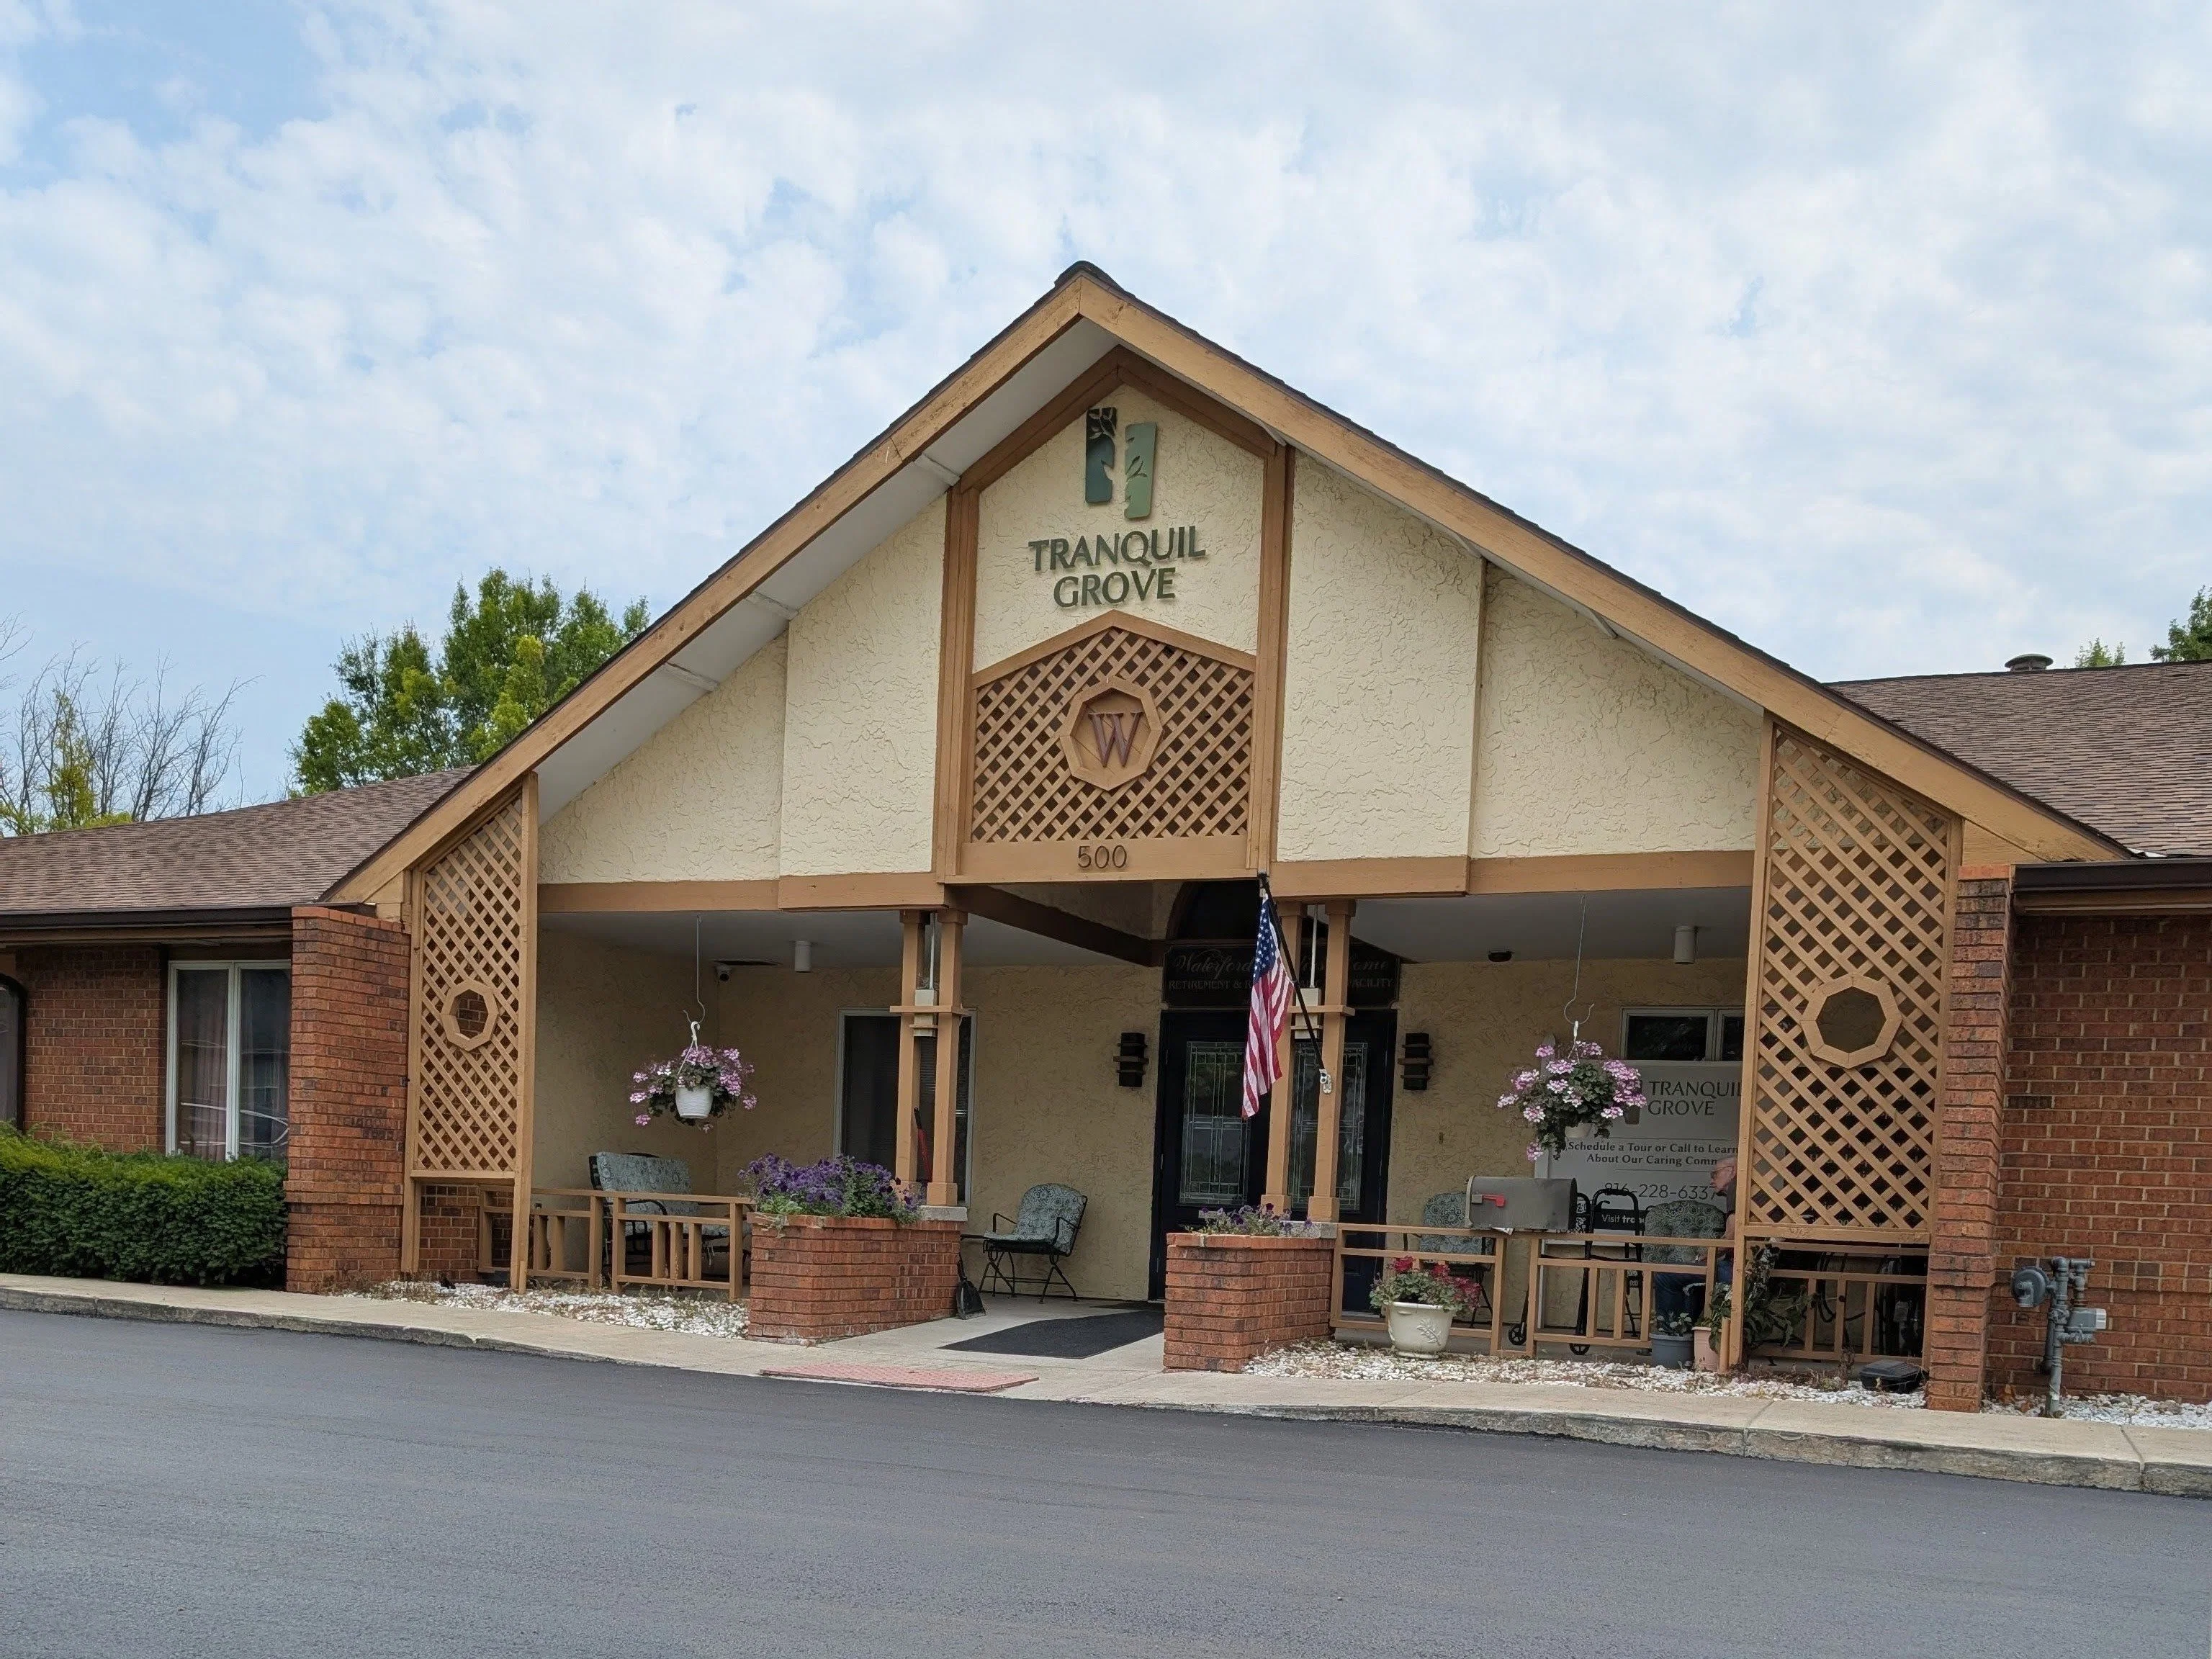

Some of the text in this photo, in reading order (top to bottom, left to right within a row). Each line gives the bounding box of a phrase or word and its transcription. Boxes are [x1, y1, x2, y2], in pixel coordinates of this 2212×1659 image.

[1028, 526, 1206, 571] TRANQUIL
[1053, 567, 1176, 608] GROVE
[1088, 711, 1144, 768] W
[1077, 845, 1128, 868] 500
[1169, 980, 1229, 990] RETIREMENT
[1352, 978, 1394, 989] ACILITY
[1649, 1080, 1742, 1098] TRANQUIL
[1647, 1100, 1715, 1116] GROVE
[1568, 1141, 1615, 1151] Schedule
[1628, 1143, 1652, 1152] Tour
[1670, 1143, 1691, 1153] Call
[1694, 1144, 1704, 1153] to
[1708, 1144, 1739, 1154] Learn
[1587, 1154, 1619, 1163] About
[1622, 1154, 1644, 1164] Our
[1646, 1156, 1682, 1167] Caring
[1601, 1214, 1620, 1223] Visit
